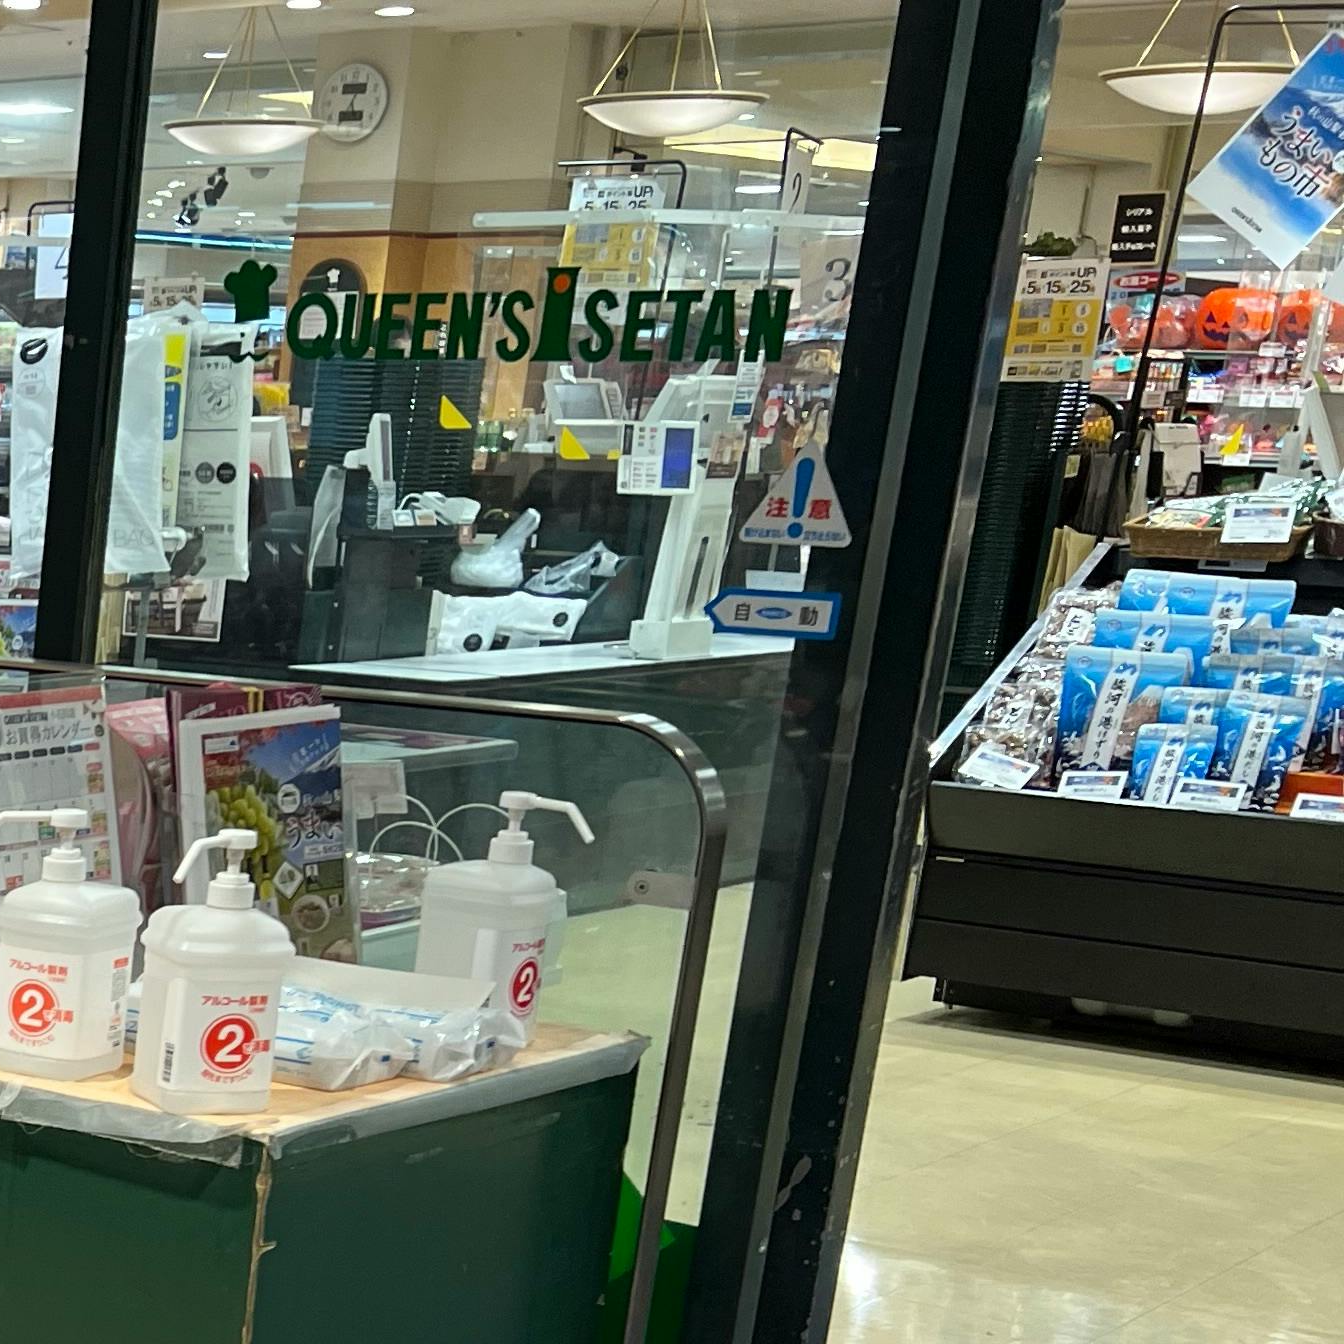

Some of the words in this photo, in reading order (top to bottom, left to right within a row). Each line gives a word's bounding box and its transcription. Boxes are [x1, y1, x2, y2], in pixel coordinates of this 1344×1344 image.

[1272, 106, 1331, 163] うまい
[1260, 138, 1331, 198] もの市
[824, 257, 852, 302] 3
[285, 289, 534, 363] QUEEN'S
[517, 966, 533, 1002] 2
[18, 989, 44, 1027] 2
[214, 1023, 245, 1063] 2
